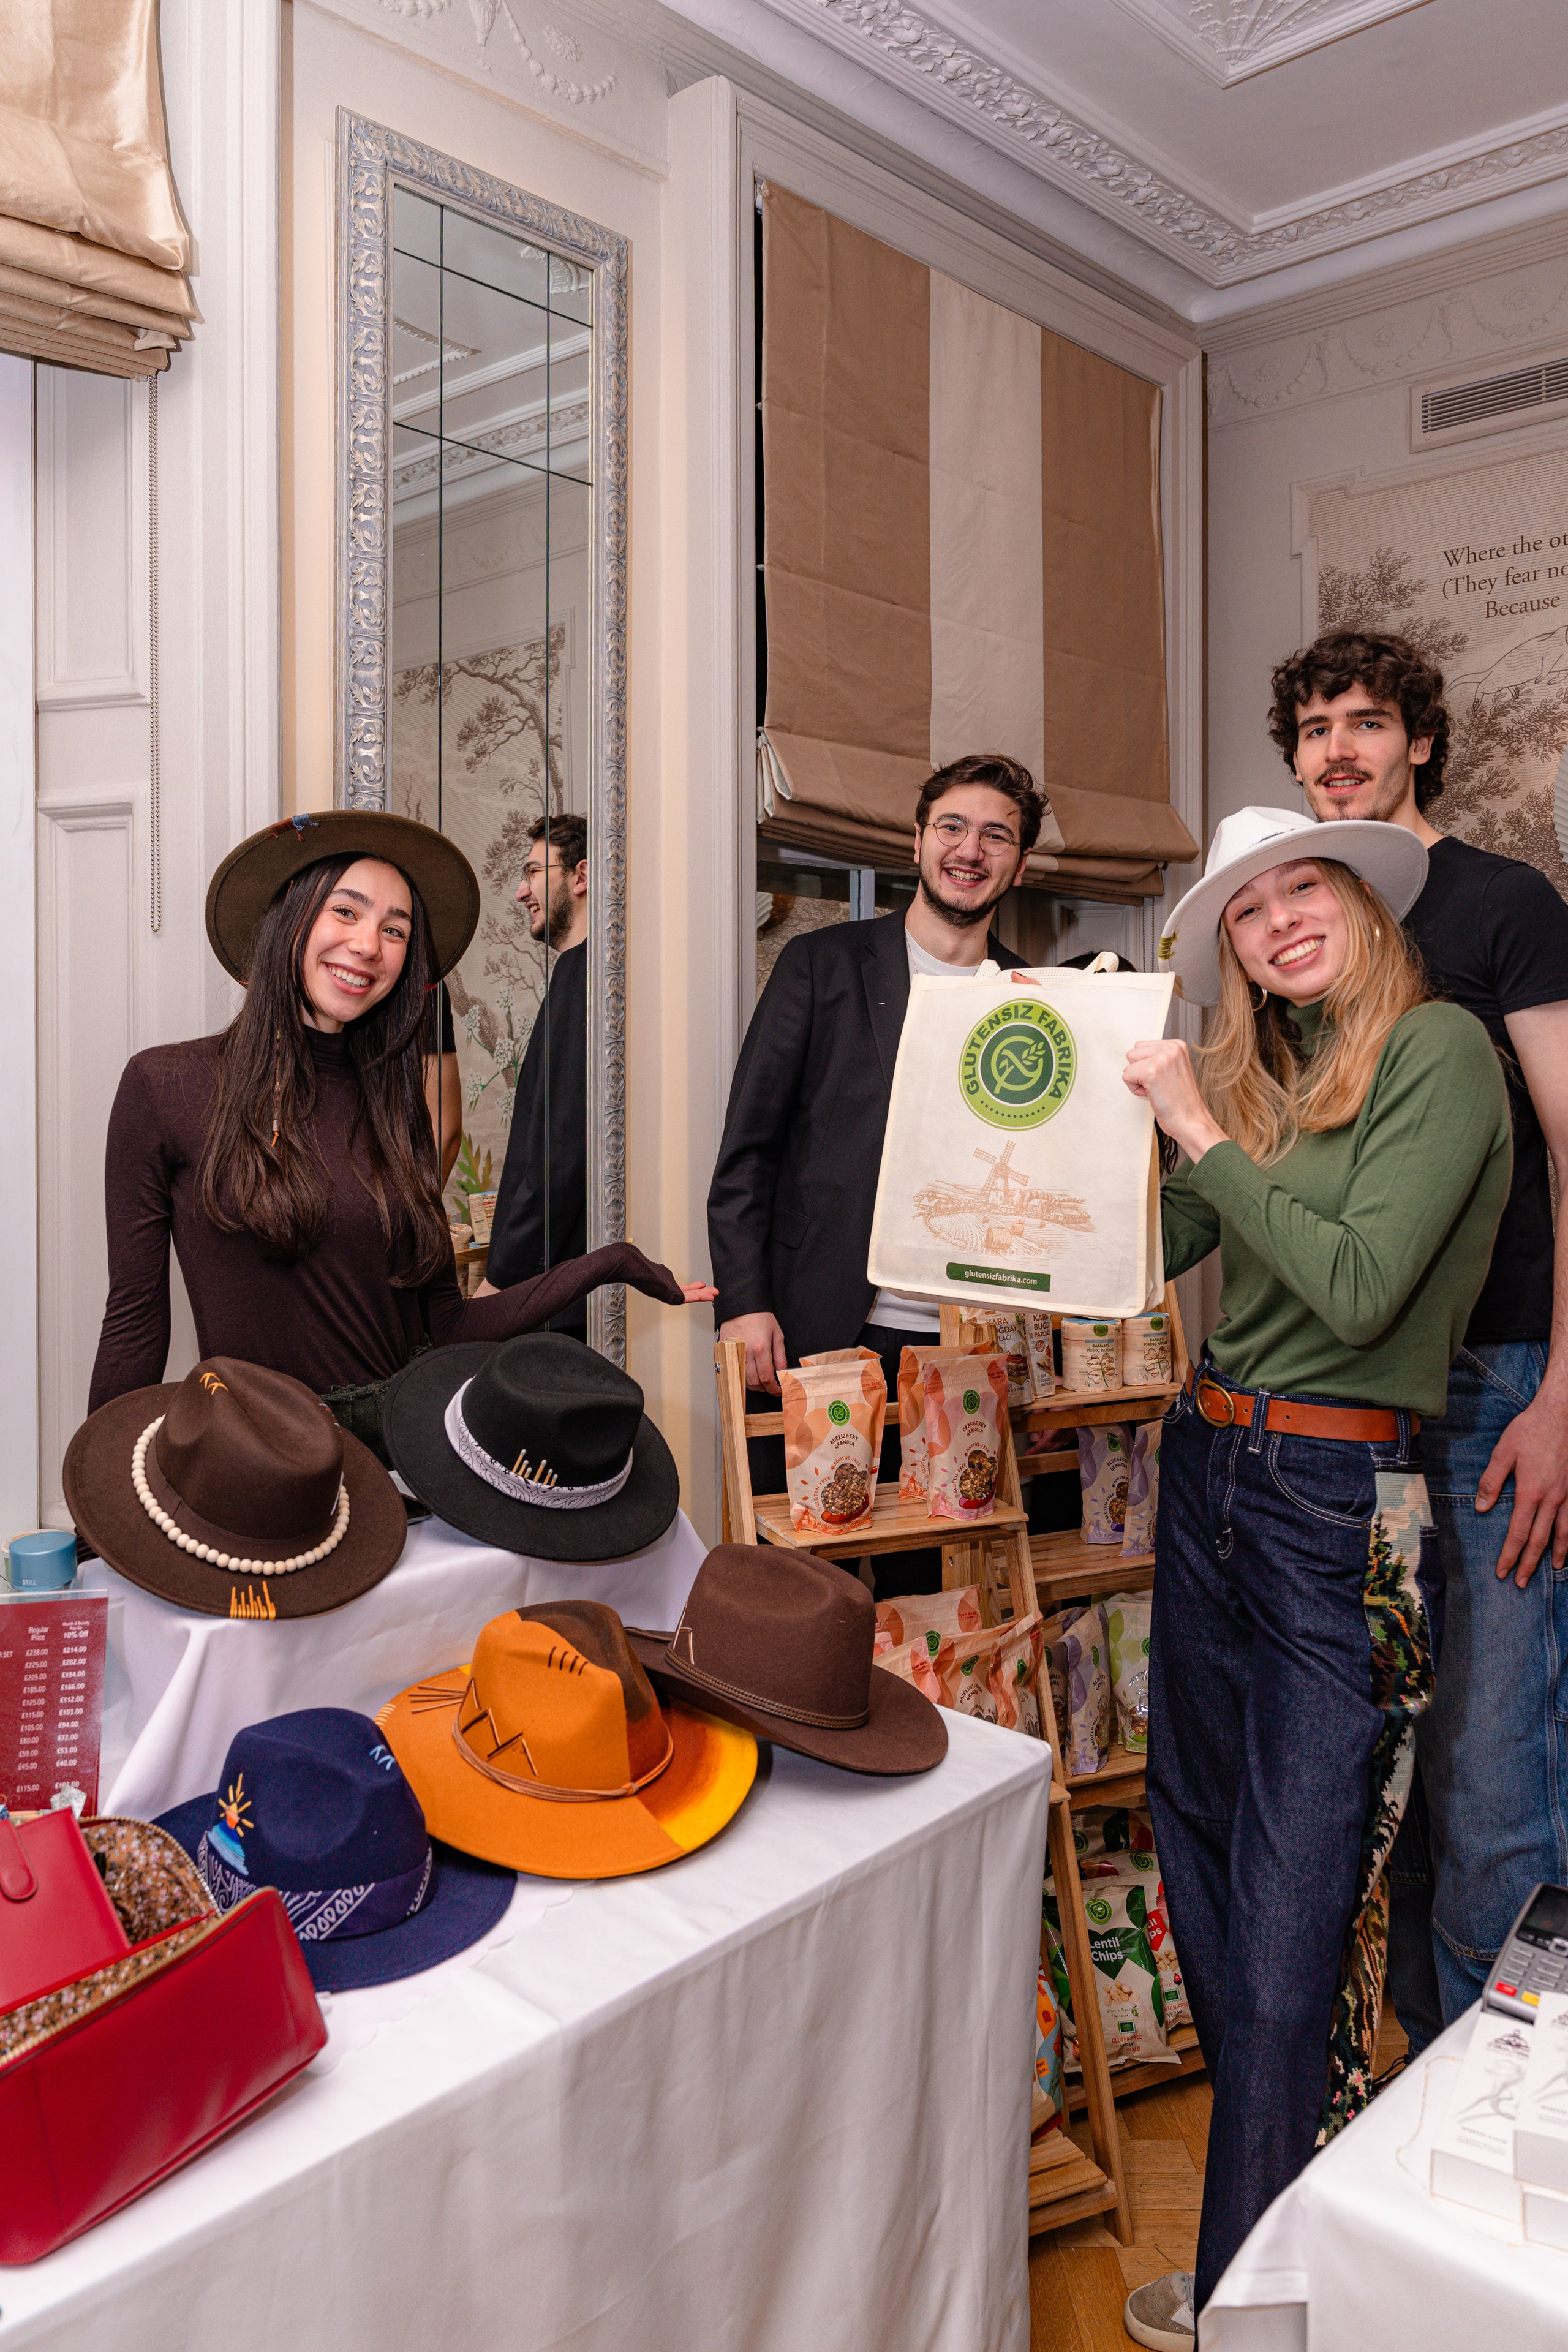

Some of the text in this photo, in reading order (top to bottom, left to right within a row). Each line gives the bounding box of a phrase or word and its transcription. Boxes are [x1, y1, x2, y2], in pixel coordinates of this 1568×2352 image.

[1443, 545, 1506, 567] Where
[1512, 535, 1543, 555] the
[1442, 575, 1499, 600] (They
[1505, 566, 1540, 586] fear
[1485, 595, 1561, 619] Because
[963, 1005, 1071, 1099] GLUTENSIZ FABRIKA
[964, 1269, 1038, 1285] glutensizfabrika.com
[1033, 1313, 1049, 1322] KARA
[997, 1324, 1017, 1335] ĞDAY
[962, 1420, 987, 1432] CRANBERRY
[966, 1427, 984, 1436] GRANOLA
[829, 1433, 859, 1446] BUCKWHEAT
[834, 1439, 855, 1449] GRANOLA
[834, 1455, 862, 1468] ADDITIVE-FREE
[957, 1463, 967, 1473] FREE
[819, 1476, 831, 1485] FREE
[62, 1645, 88, 1654] £214.00
[24, 1660, 48, 1669] £225.00
[62, 1657, 87, 1666] £202.00
[59, 1695, 85, 1703] £112.00
[960, 1684, 974, 1705] HAZELNUT
[21, 1711, 45, 1719] £115.00
[17, 1784, 40, 1793] £115.00
[1147, 1918, 1158, 1928] til
[1091, 1950, 1123, 1962] Chips
[1164, 2002, 1189, 2012] UTEN-FREE
[1112, 2034, 1143, 2044] GLUTEN-FREE
